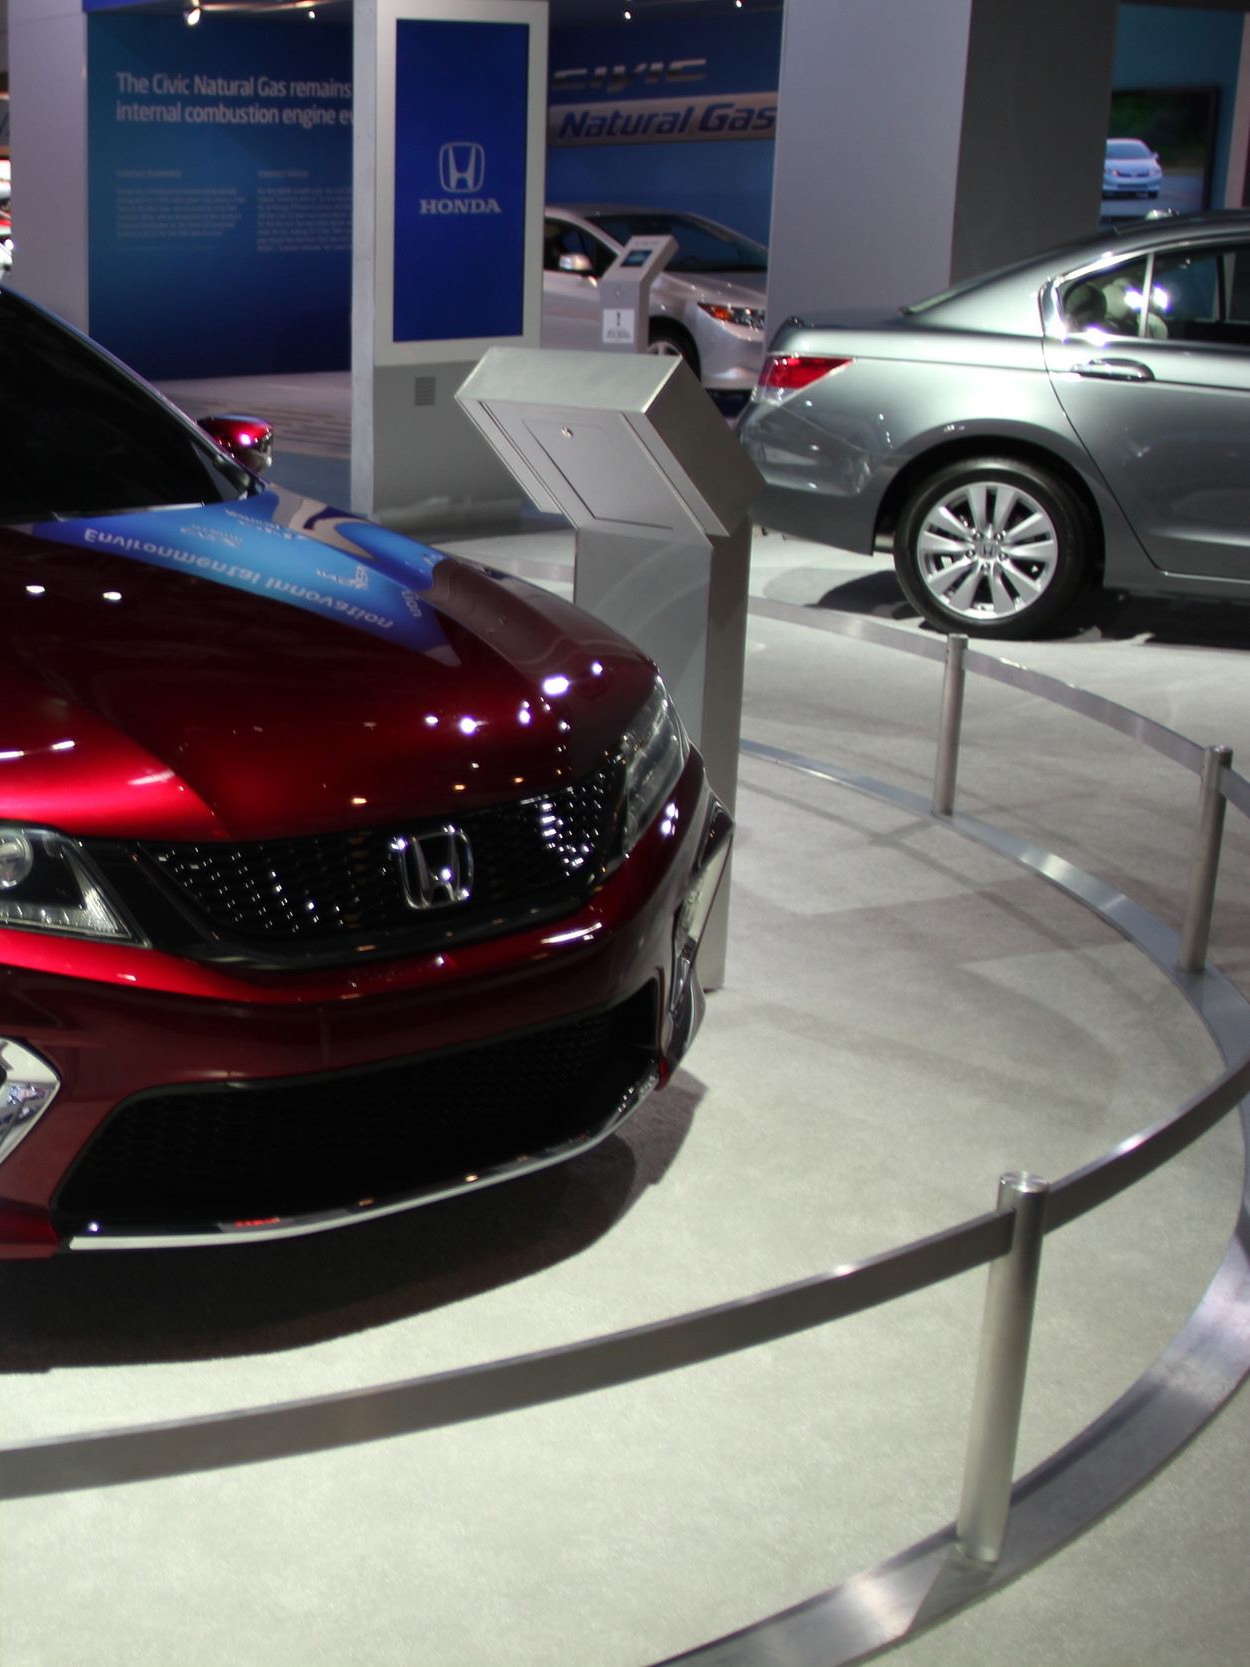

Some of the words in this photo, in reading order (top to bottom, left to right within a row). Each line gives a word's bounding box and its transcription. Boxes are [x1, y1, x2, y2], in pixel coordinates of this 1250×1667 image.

[115, 72, 149, 94] The
[152, 73, 190, 95] Civic
[193, 75, 254, 96] Natural
[257, 76, 287, 97] Gas
[290, 77, 353, 98] remains
[116, 101, 181, 122] internal
[184, 103, 279, 124] combustion
[282, 105, 335, 129] engine
[556, 105, 694, 139] Natural
[697, 102, 776, 133] Gas
[419, 199, 502, 215] HONDA
